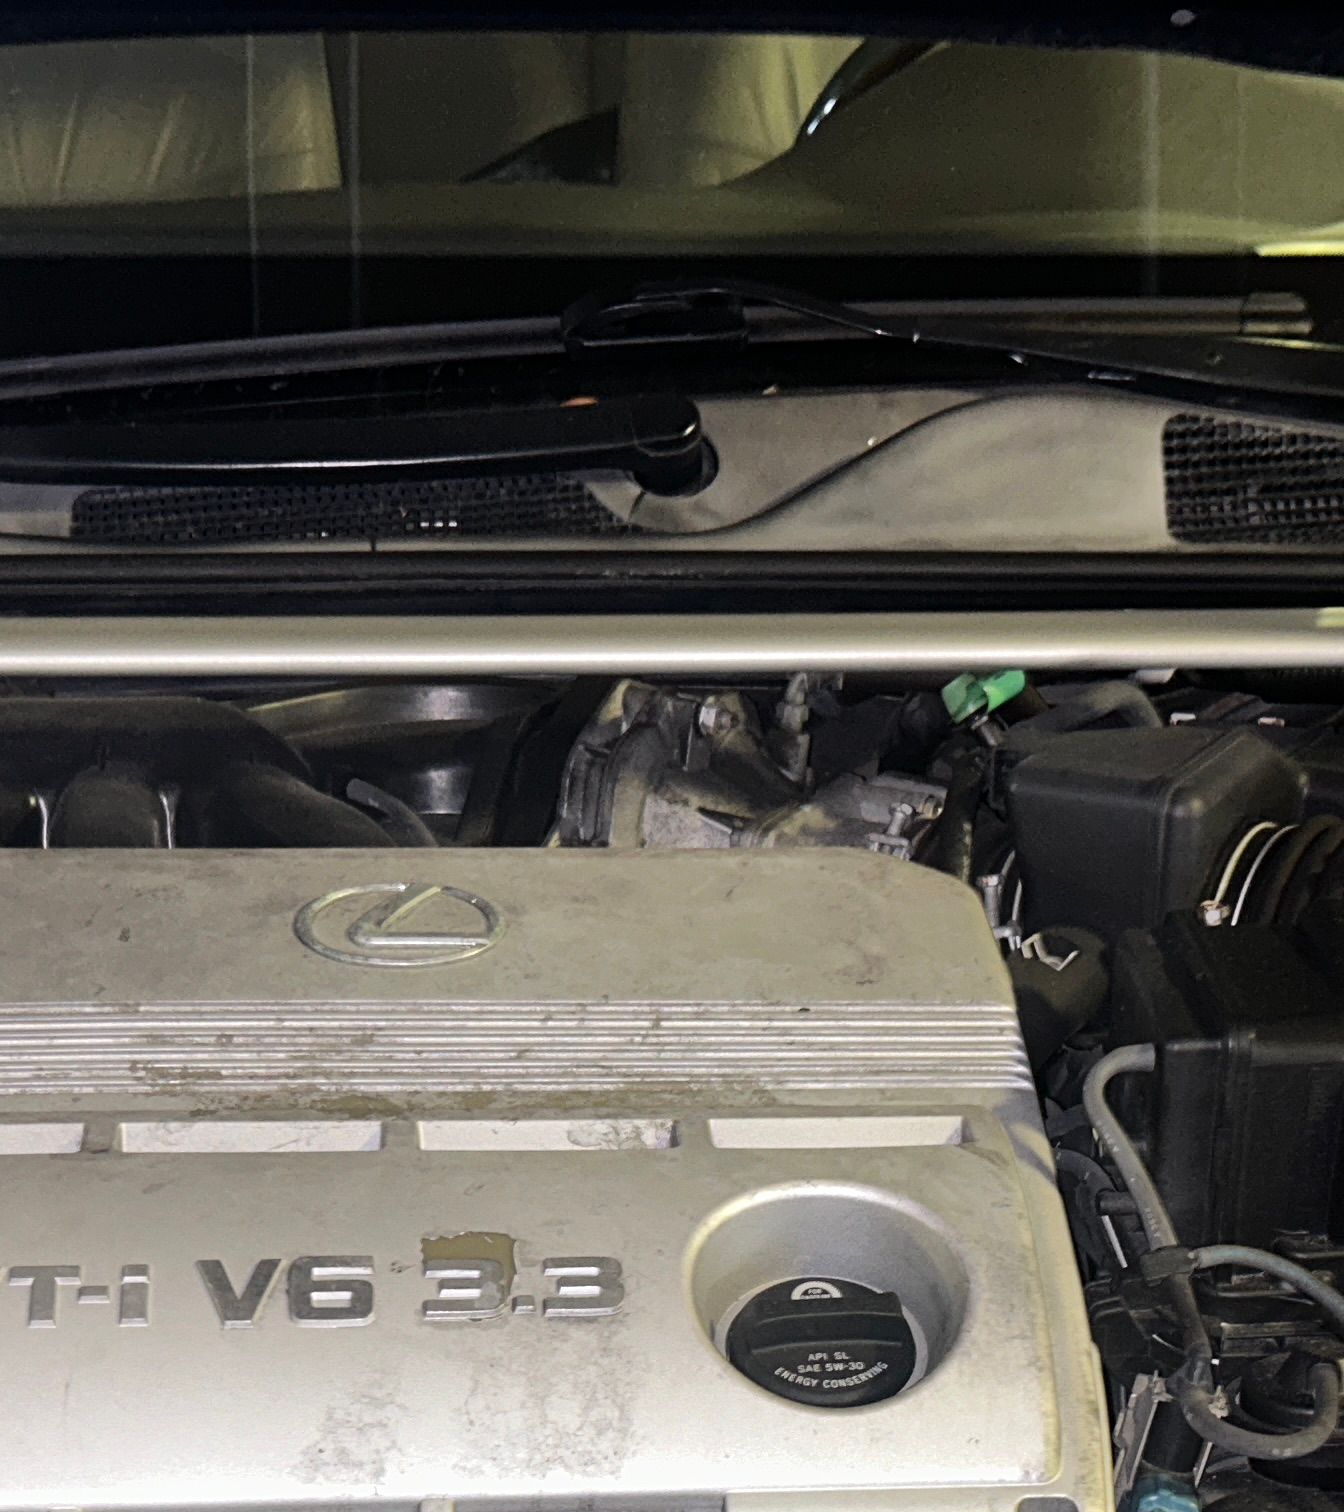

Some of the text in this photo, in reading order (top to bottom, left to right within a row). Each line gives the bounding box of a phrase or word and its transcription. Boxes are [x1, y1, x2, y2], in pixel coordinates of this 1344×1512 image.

[195, 1254, 376, 1330] V6
[421, 1255, 628, 1322] 3.3
[808, 1351, 850, 1361] API SL
[774, 1361, 889, 1388] ENERGY CONSERVING
[797, 1361, 865, 1373] SAE 5W-30
